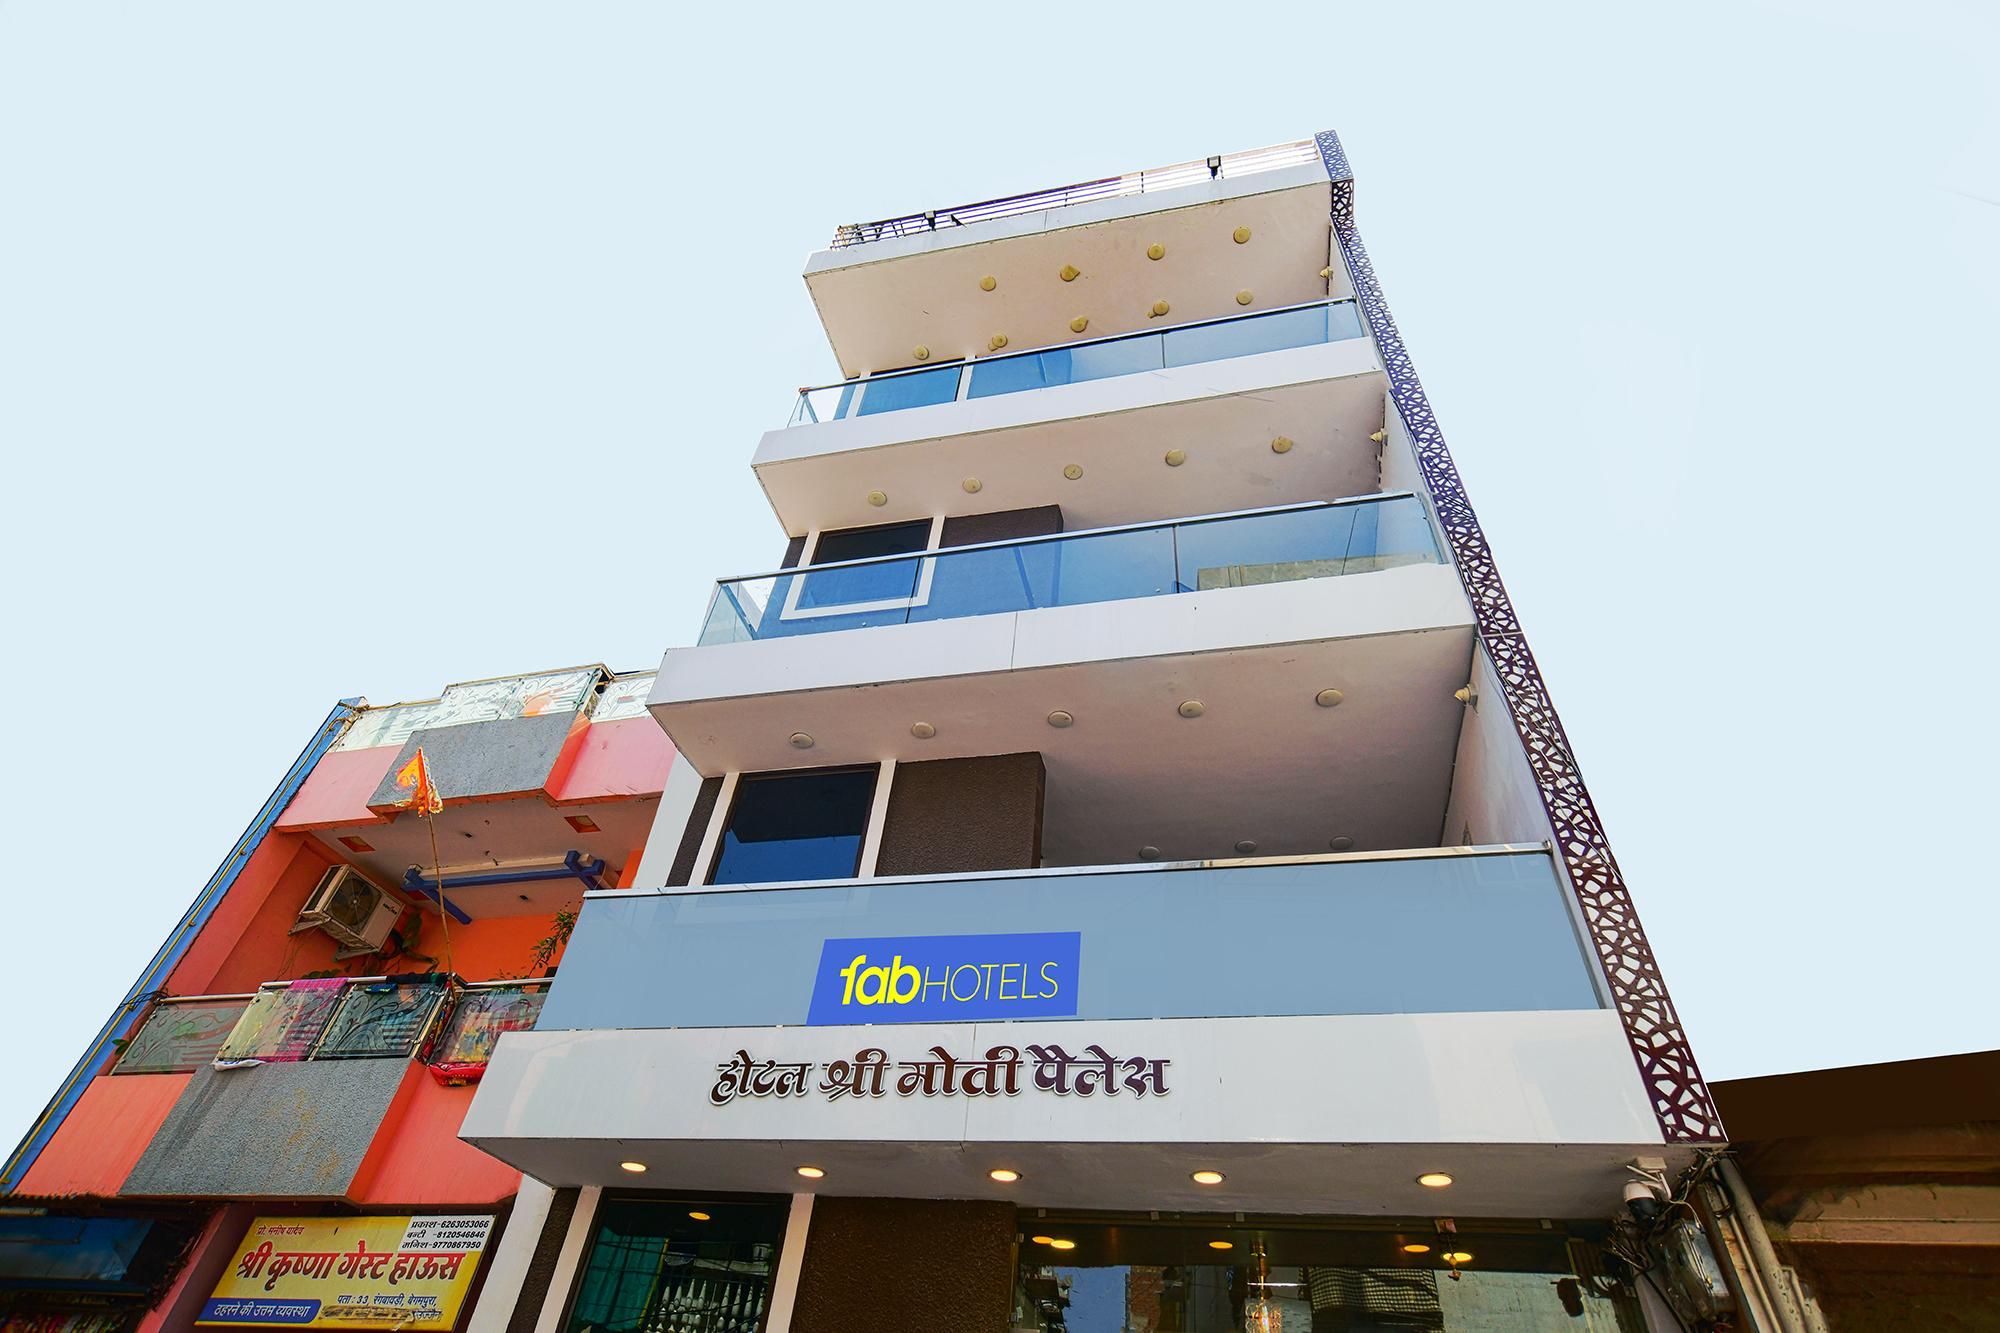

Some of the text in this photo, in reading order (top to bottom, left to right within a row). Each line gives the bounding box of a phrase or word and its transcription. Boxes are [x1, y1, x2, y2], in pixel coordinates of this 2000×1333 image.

[709, 1043, 1172, 1106] होटल श्री मोती पैलेस
[236, 1240, 468, 1291] श्री कृष्णा गेस्ट हाऊस
[214, 1302, 240, 1317] ठहरने
[240, 1301, 254, 1316] की
